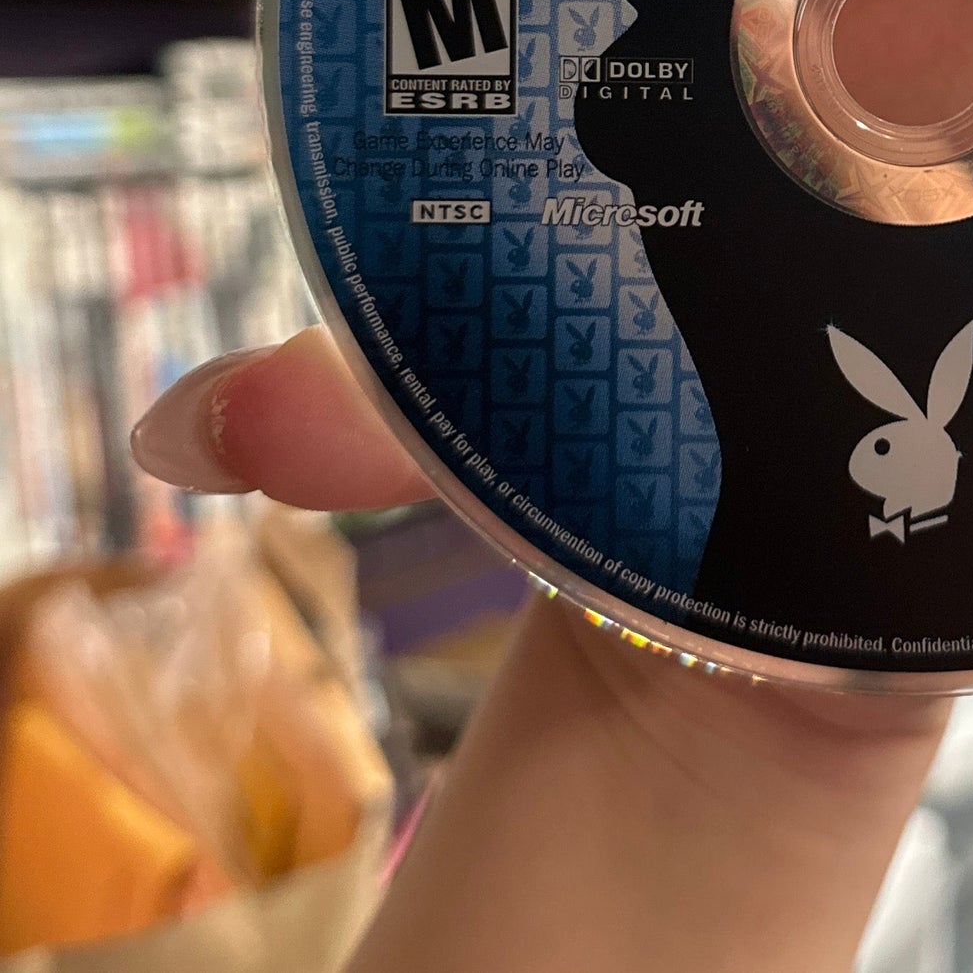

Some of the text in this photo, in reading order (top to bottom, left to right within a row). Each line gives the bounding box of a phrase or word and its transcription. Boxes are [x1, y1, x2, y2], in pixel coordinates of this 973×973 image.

[296, 22, 317, 117] engineering,
[609, 61, 689, 79] DOLBY
[391, 79, 512, 92] CONTENT RATED BY
[559, 86, 694, 100] DIGITAL
[391, 92, 512, 109] ESRB
[353, 132, 565, 155] Game Experience May
[305, 119, 336, 224] transmission,
[334, 157, 585, 182] Change During Online Play
[419, 198, 705, 227] NTSC Microsoft
[326, 225, 357, 273] public
[345, 273, 402, 370] performance,
[398, 367, 436, 415] rental,
[427, 411, 455, 441] pay
[450, 432, 471, 456] for
[464, 453, 496, 487] play,
[495, 481, 513, 498] or
[509, 493, 602, 565] circumvention
[601, 559, 622, 575] of
[618, 568, 654, 597] copy
[652, 586, 731, 624] protection
[732, 611, 747, 629] is
[747, 618, 800, 646] strictly
[801, 632, 886, 653] prohibited.
